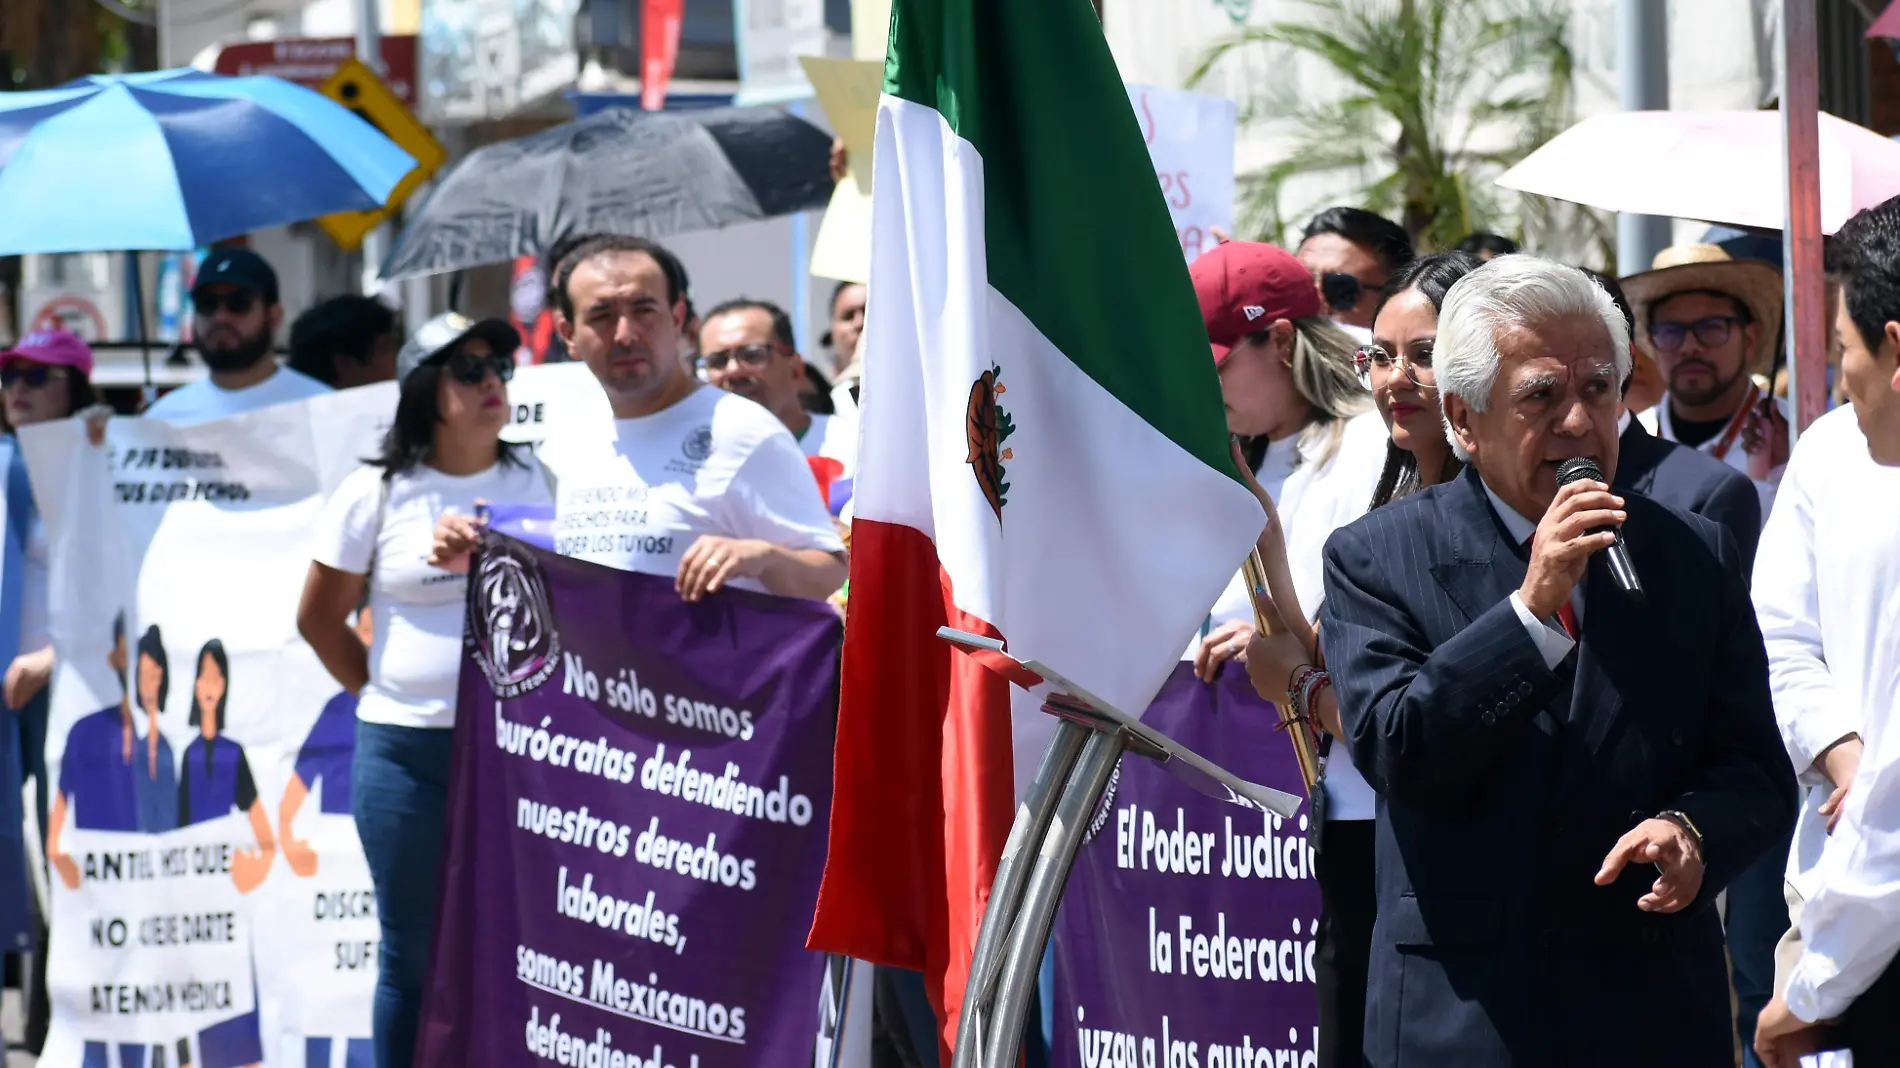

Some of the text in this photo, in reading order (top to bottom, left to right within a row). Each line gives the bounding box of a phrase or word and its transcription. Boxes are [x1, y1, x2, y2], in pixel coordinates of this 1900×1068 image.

[563, 651, 754, 741] No sólo somos
[495, 700, 812, 826] burócratas defendiendo
[517, 798, 757, 891] nuestros derechos
[1117, 803, 1316, 880] El Poder Judici
[91, 918, 128, 948] NO
[315, 890, 377, 920] DISCR
[556, 865, 687, 955] laborales,
[1149, 906, 1319, 984] la Federació
[516, 944, 746, 1039] somos Mexicanos
[525, 1004, 676, 1068] defendiend
[1162, 1015, 1199, 1068] las
[1207, 1026, 1319, 1068] autorid
